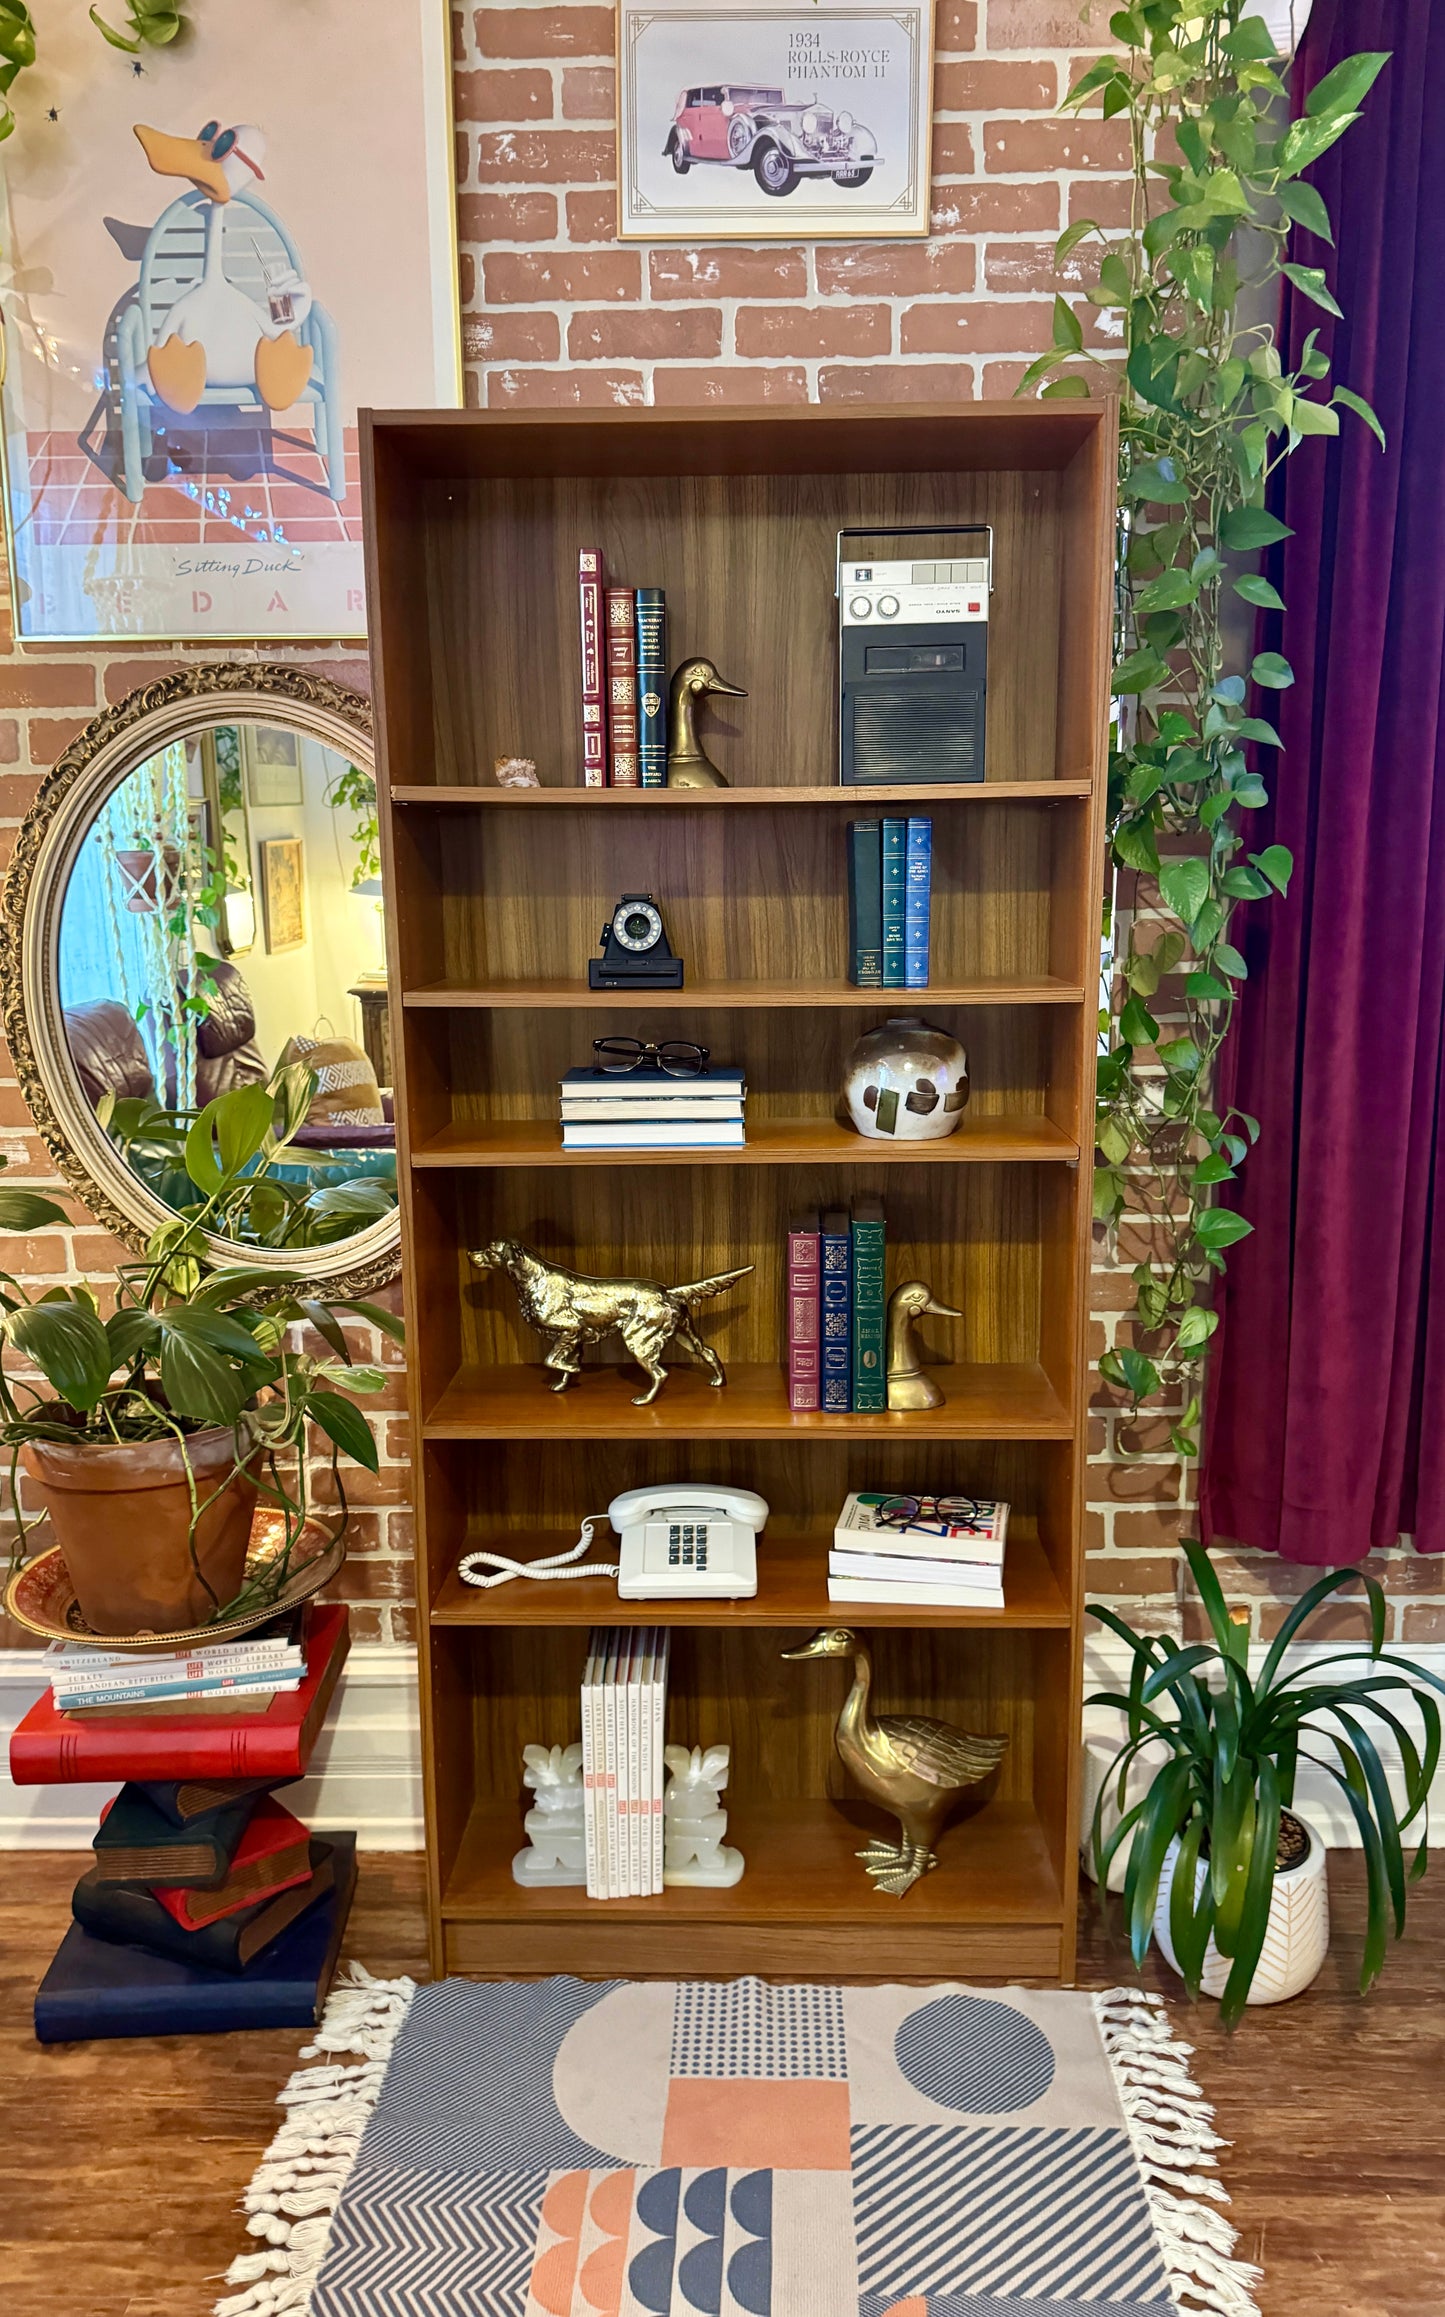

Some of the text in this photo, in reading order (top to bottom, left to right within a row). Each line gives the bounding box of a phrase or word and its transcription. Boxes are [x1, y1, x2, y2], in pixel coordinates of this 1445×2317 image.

[788, 33, 820, 48] 1934
[788, 50, 890, 64] ROLLS-ROYCE
[788, 65, 866, 79] PHANTOM
[59, 1645, 273, 1666] SWITZERLAND LIFE WORLD LIBRARY
[68, 1653, 284, 1683] TURKEY LIFE WORLD LIBRARY
[69, 1661, 285, 1693] THE ANDEAN REPUBLICS LIFE WORLD LIBRARY
[76, 1697, 94, 1705] THE
[96, 1690, 146, 1703] MOUNTAINS
[206, 1687, 240, 1696] WORLD
[246, 1684, 283, 1694] LIBRARY
[632, 1739, 638, 1748] OF
